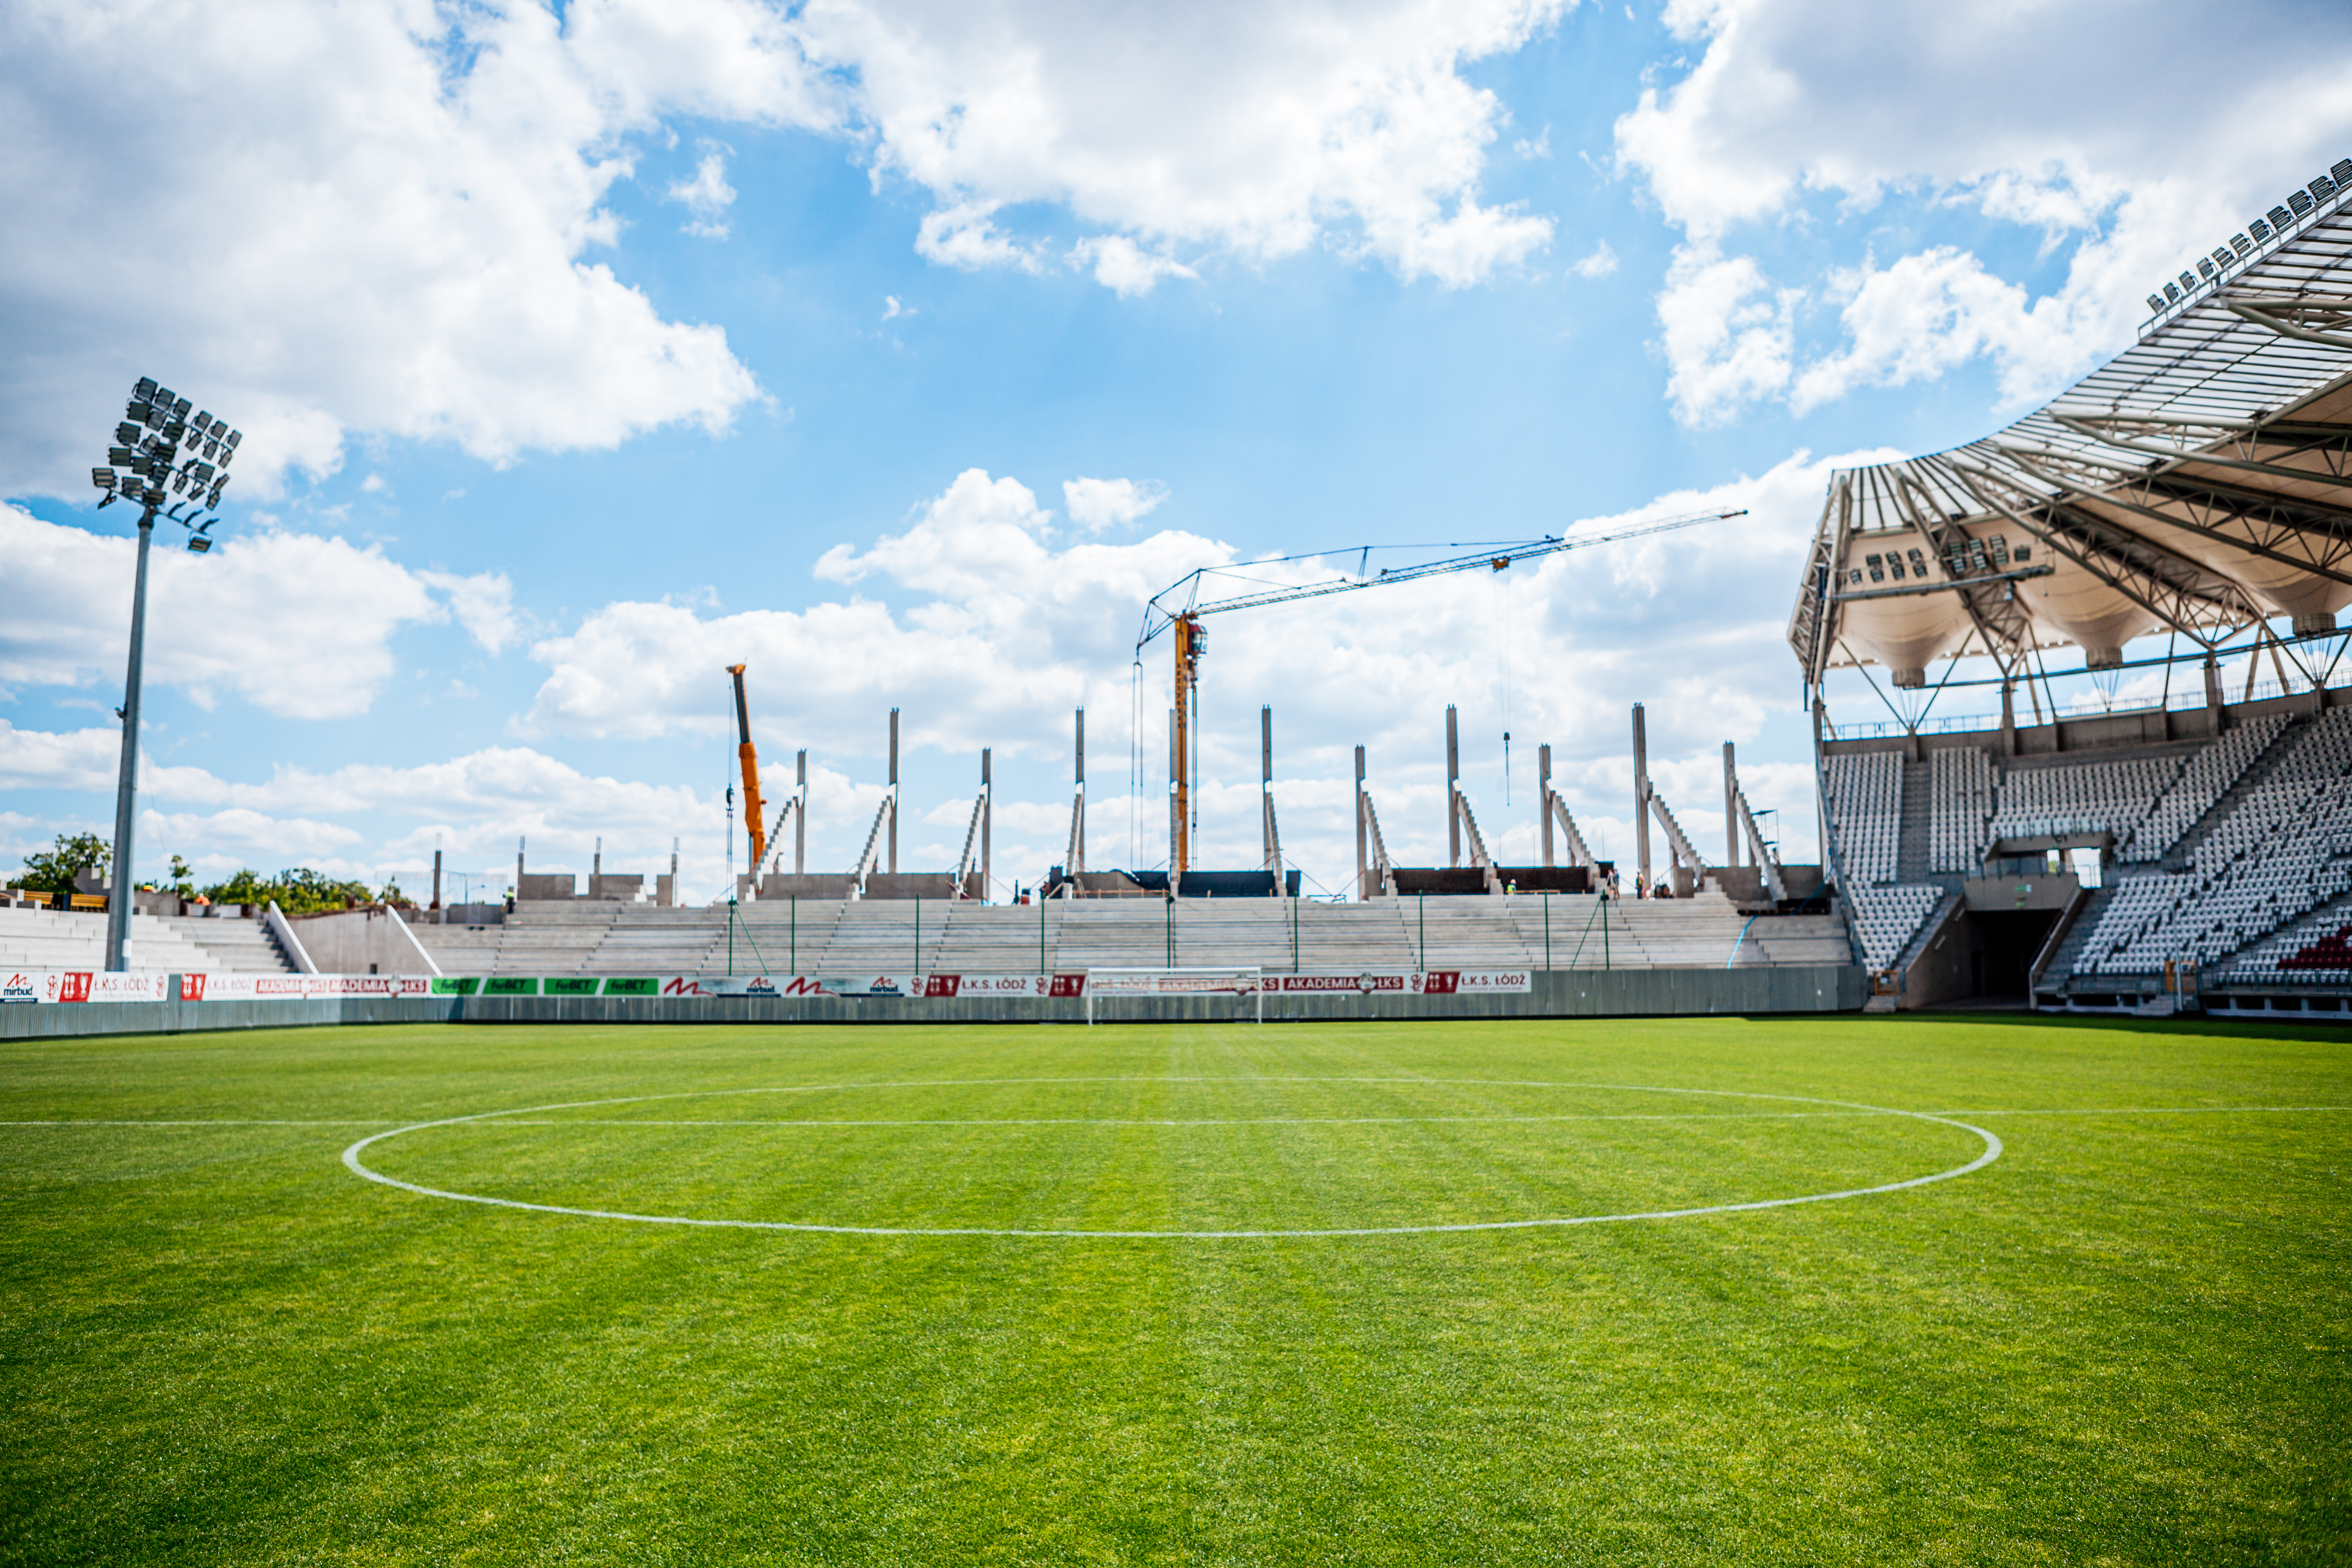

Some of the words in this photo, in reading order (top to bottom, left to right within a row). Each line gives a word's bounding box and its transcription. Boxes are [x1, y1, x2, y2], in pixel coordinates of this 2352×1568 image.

[996, 976, 1026, 989] ŁÓDŹ
[1287, 977, 1357, 989] AKADEMIA
[1496, 972, 1525, 985] ŁÓDŹ
[4, 985, 33, 995] mirbud
[330, 980, 388, 991] AKADEMIA
